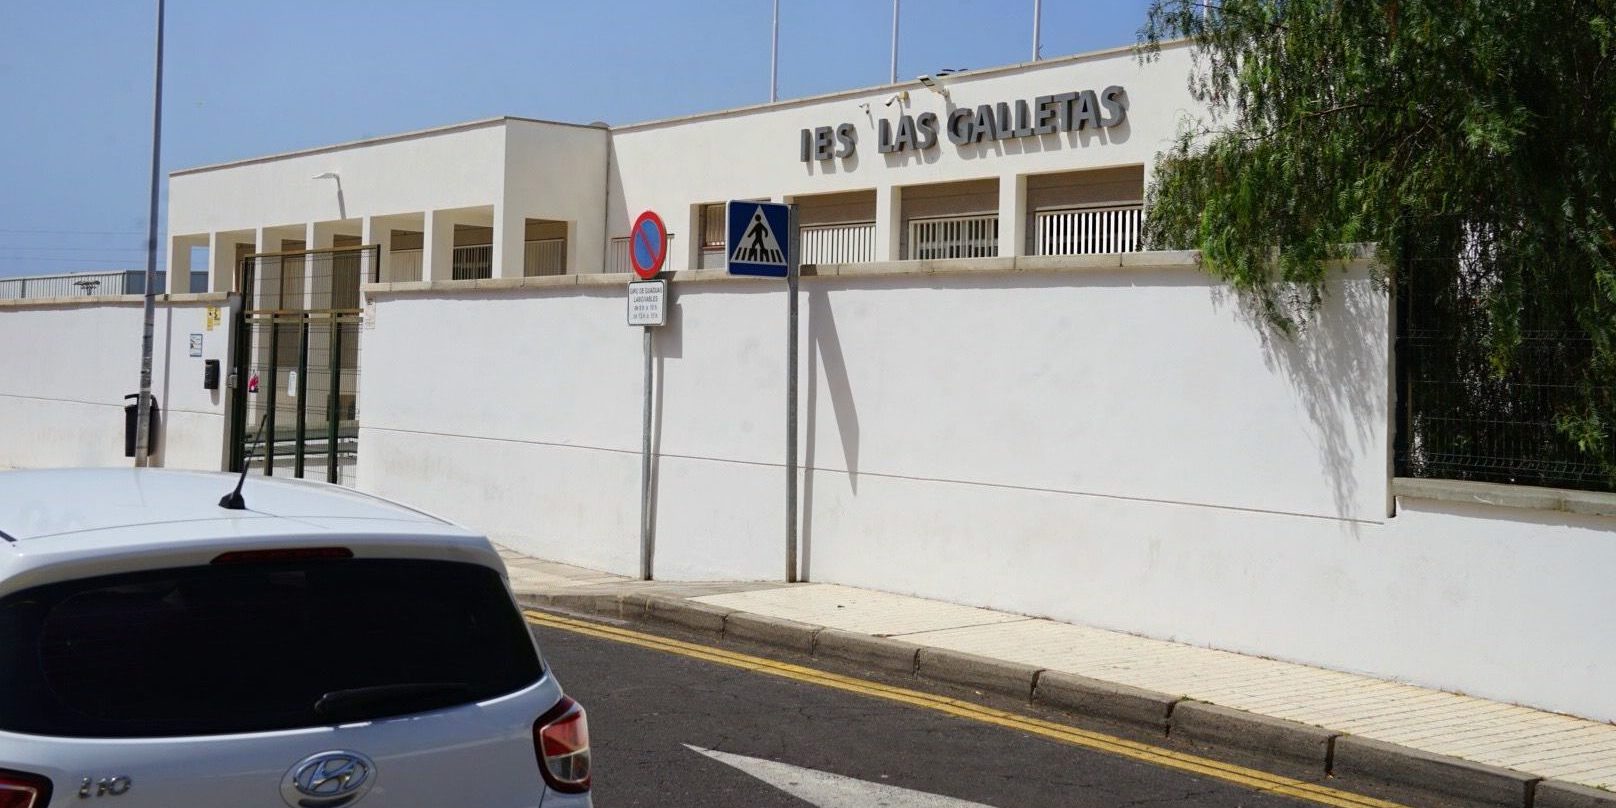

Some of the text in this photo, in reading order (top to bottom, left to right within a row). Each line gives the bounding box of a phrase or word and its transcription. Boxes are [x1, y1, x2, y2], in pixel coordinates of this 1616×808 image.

[800, 85, 1126, 163] IES LAS GALLETAS
